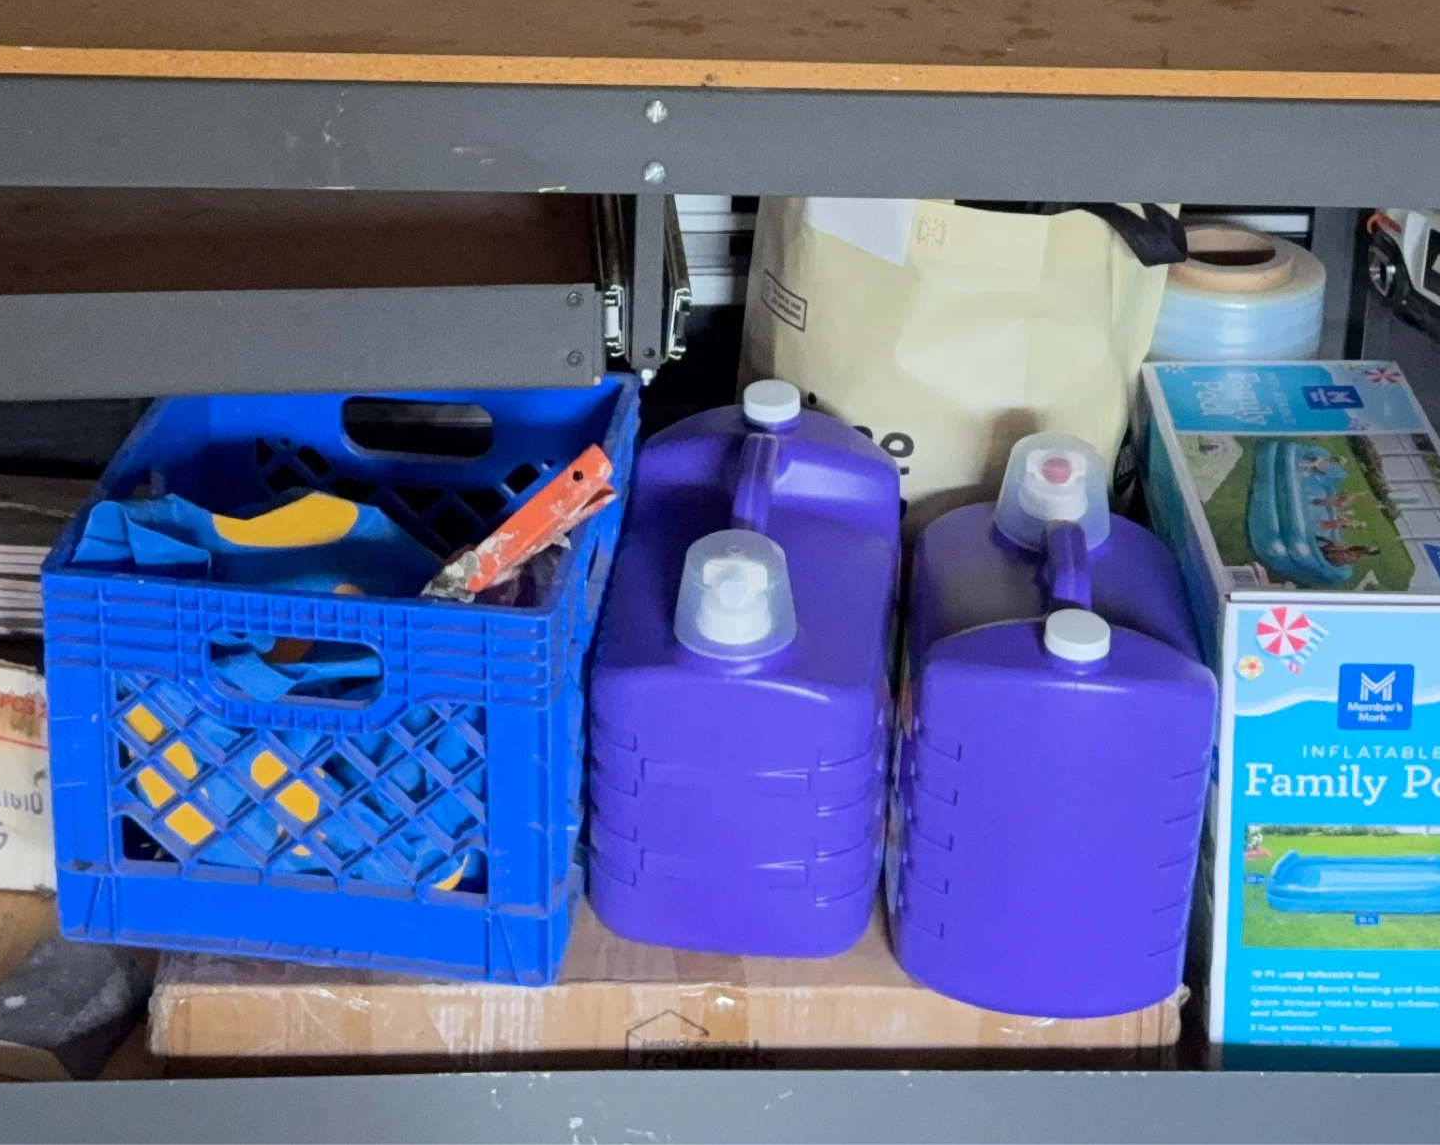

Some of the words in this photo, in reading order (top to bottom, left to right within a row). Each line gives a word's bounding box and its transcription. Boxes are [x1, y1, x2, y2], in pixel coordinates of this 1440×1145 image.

[1192, 381, 1235, 415] Pool
[1227, 371, 1274, 425] Family
[1347, 702, 1403, 712] Member's
[1359, 713, 1387, 722] Mark
[1244, 763, 1388, 806] Family
[1278, 971, 1304, 980] Long
[1307, 971, 1354, 979] Inflatable
[1251, 985, 1314, 993] Comfortable
[1317, 985, 1349, 994] Bench
[1352, 985, 1391, 995] Seating
[1393, 986, 1412, 994] and
[1251, 998, 1279, 1007] Quick
[1371, 1000, 1394, 1009] Easy
[1397, 1000, 1440, 1008] Inflation
[1339, 1024, 1392, 1033] Beverages
